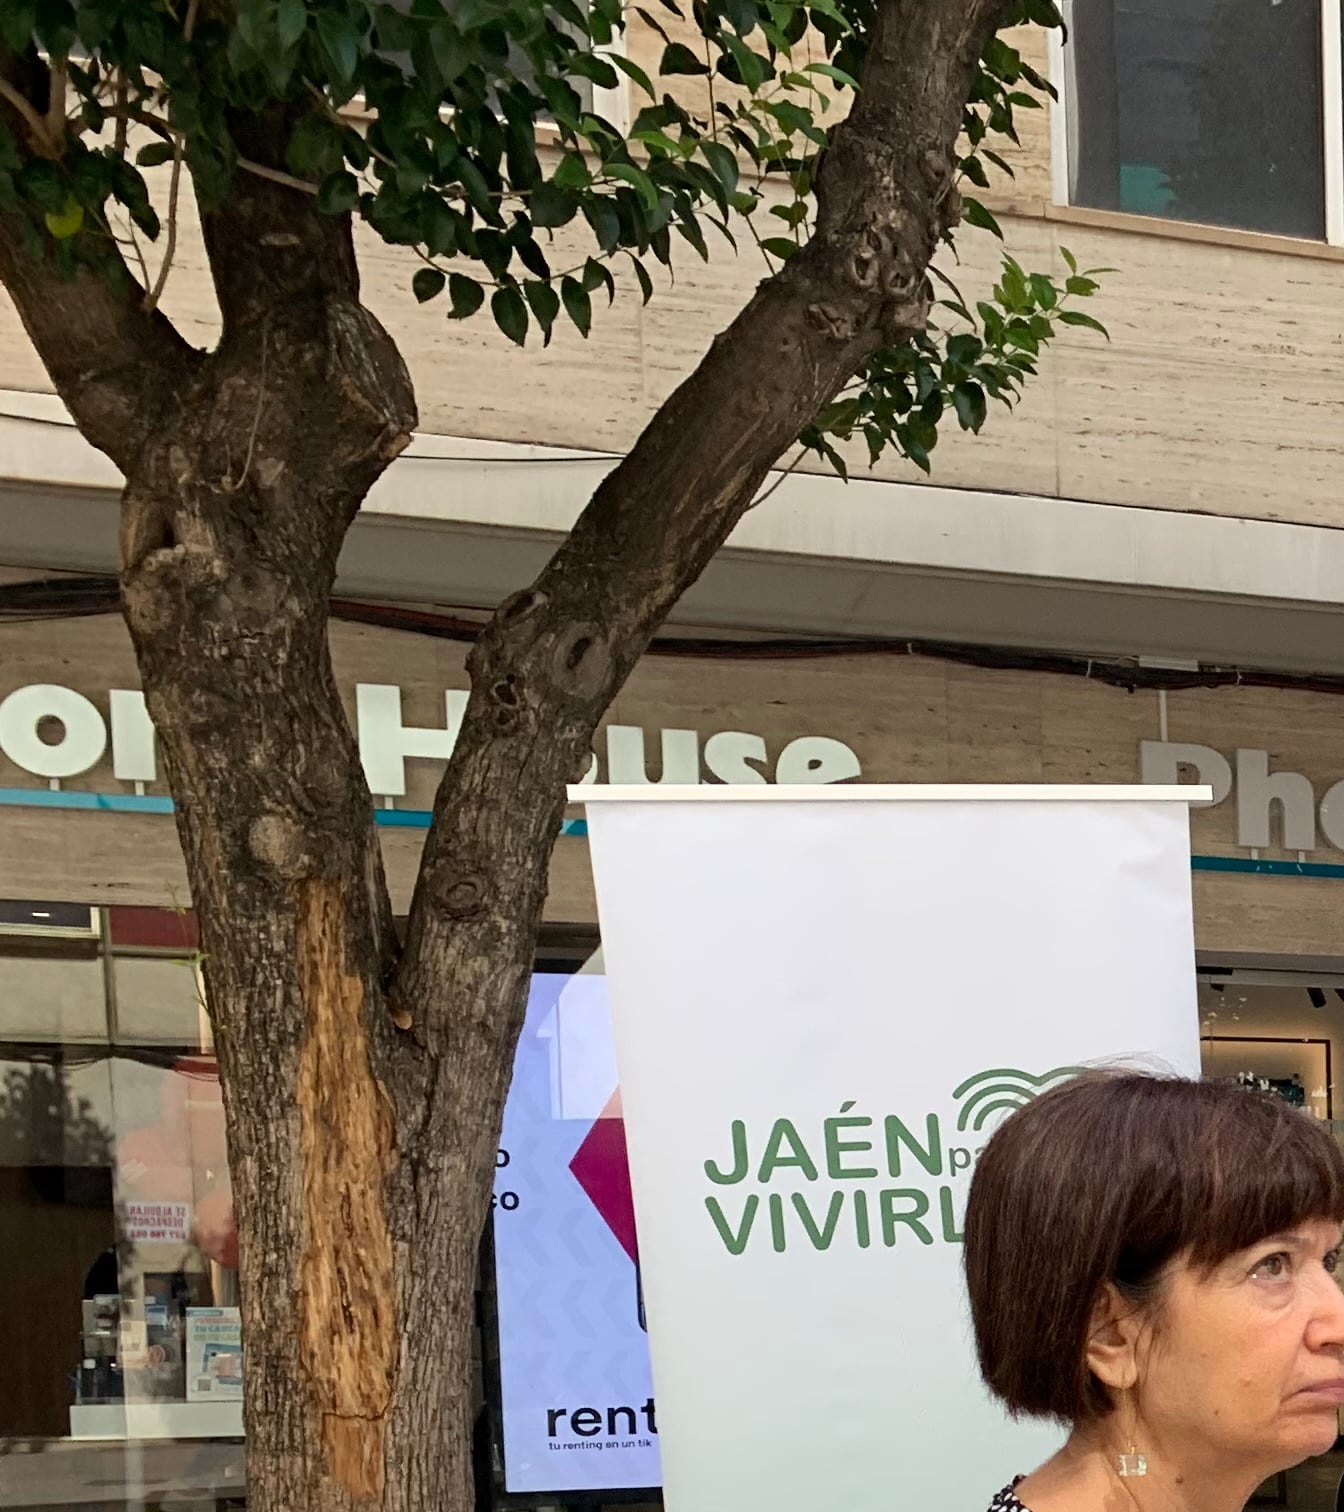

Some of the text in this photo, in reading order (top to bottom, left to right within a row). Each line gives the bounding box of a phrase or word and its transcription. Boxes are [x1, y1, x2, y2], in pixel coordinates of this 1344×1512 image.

[356, 683, 862, 795] Huse
[704, 1101, 943, 1185] JAÉN
[704, 1185, 966, 1256] VIVIRL
[546, 1398, 658, 1437] rent
[549, 1439, 652, 1451] tu renting en un tik
